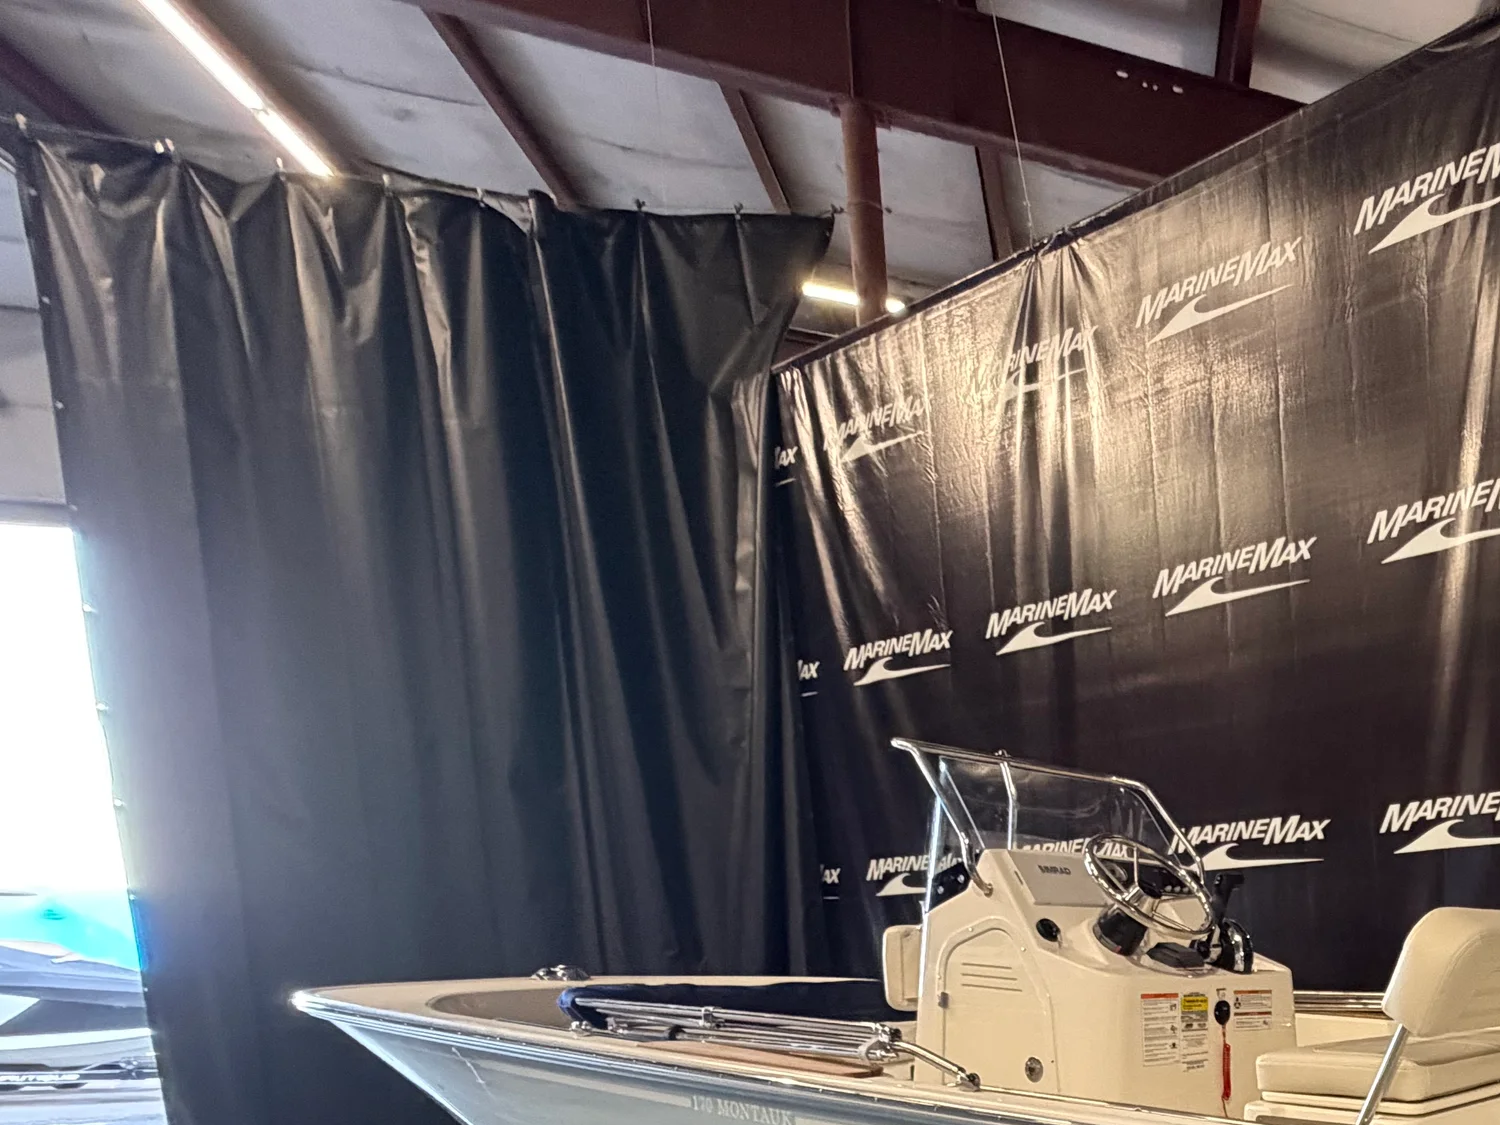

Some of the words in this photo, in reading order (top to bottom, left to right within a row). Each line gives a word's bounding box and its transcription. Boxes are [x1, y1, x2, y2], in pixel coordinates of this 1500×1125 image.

[1135, 236, 1302, 328] MARINEMAX
[1152, 536, 1317, 599] MARINEMAX
[985, 588, 1117, 639] MARINEMAX
[843, 628, 953, 671] MARINEMAX
